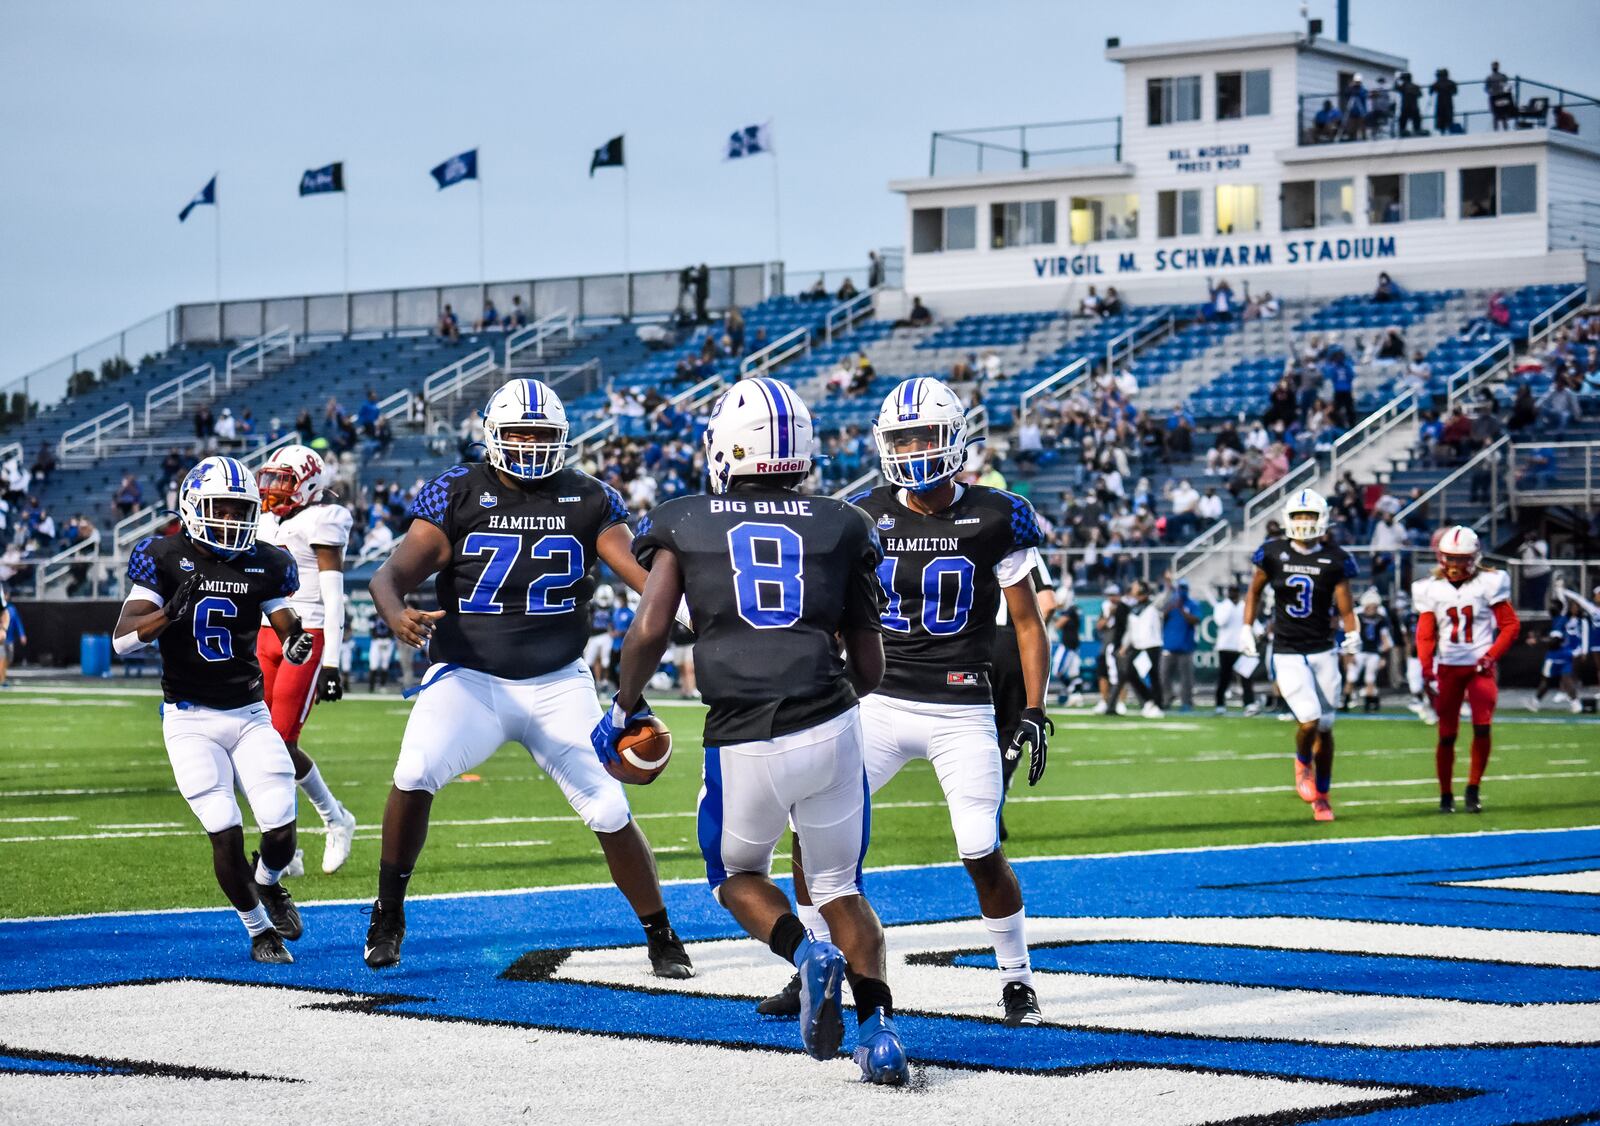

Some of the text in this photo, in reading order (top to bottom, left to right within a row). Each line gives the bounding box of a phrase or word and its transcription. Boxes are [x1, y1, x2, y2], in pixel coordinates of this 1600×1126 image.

[1034, 236, 1397, 278] VIRGIL M. SCHWARM STADIUM
[756, 460, 805, 474] Riddell
[488, 514, 567, 531] HAMILTON
[709, 499, 813, 517] BIG BLUE
[886, 537, 960, 552] HAMILTON
[198, 580, 249, 594] AMILTON
[458, 532, 585, 616] 72
[726, 521, 805, 630] 8
[876, 555, 976, 636] 10
[1285, 574, 1315, 618] 3
[192, 596, 238, 662] 6
[1446, 604, 1474, 644] 11
